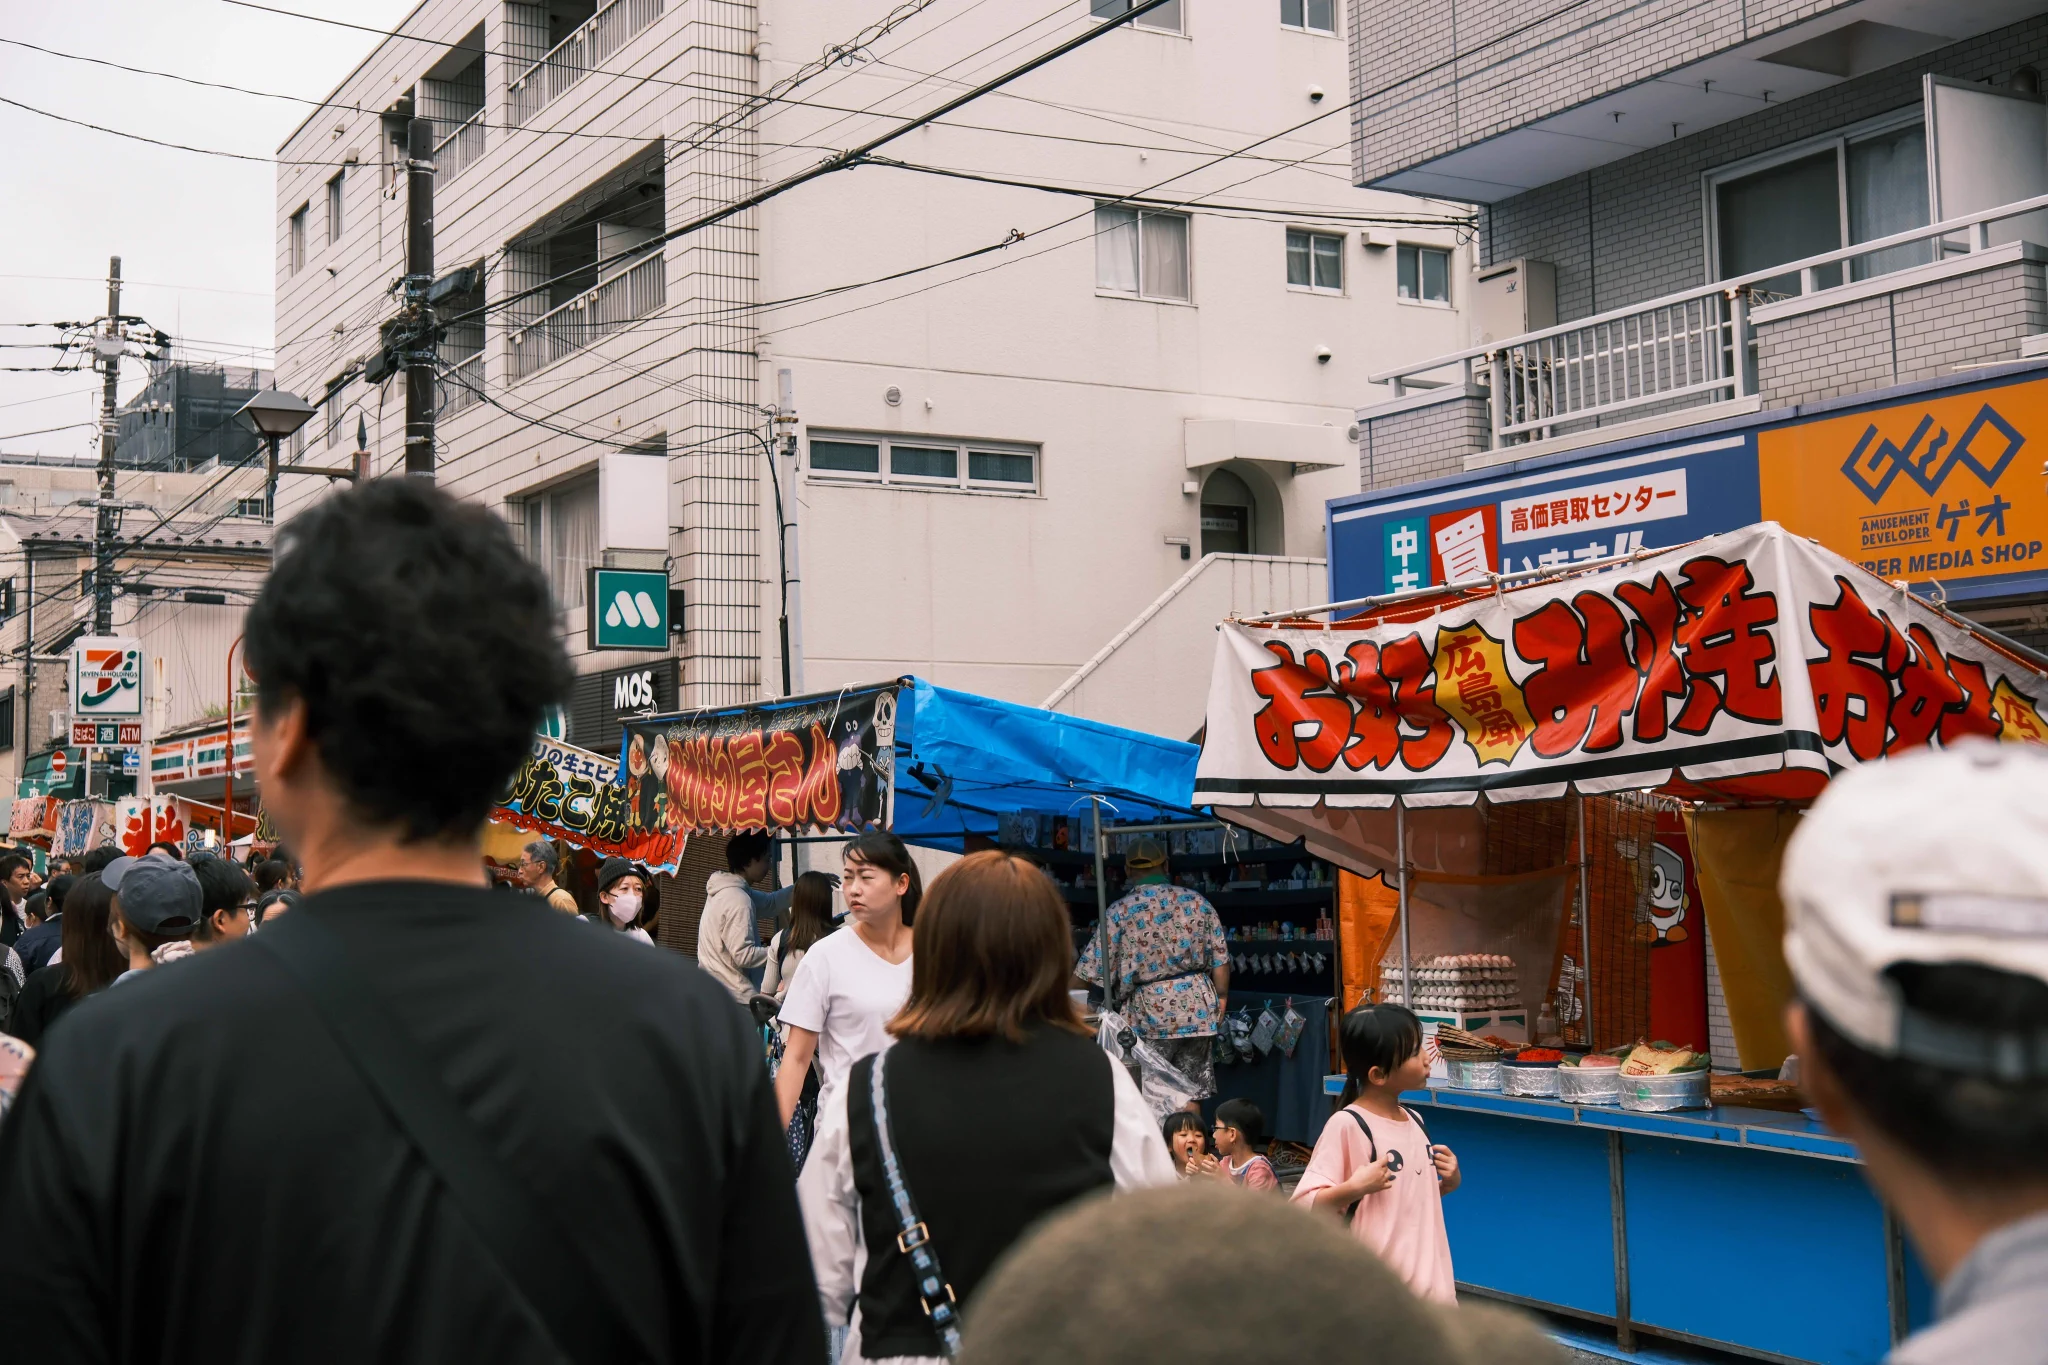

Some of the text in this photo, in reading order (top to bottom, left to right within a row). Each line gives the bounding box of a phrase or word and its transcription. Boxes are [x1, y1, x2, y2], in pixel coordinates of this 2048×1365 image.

[1510, 485, 1676, 533] 高価買取センター
[1861, 512, 1930, 532] AMUSEMENT
[1935, 494, 2012, 542] ゲオ
[1861, 527, 1930, 546] DEVELOPER
[1858, 540, 2043, 577] PER MEDIA SHOP
[614, 670, 653, 710] MOS
[1441, 634, 1526, 748] 広島風
[73, 727, 95, 741] たばこ
[100, 727, 114, 741] 酒
[120, 727, 140, 741] ATM
